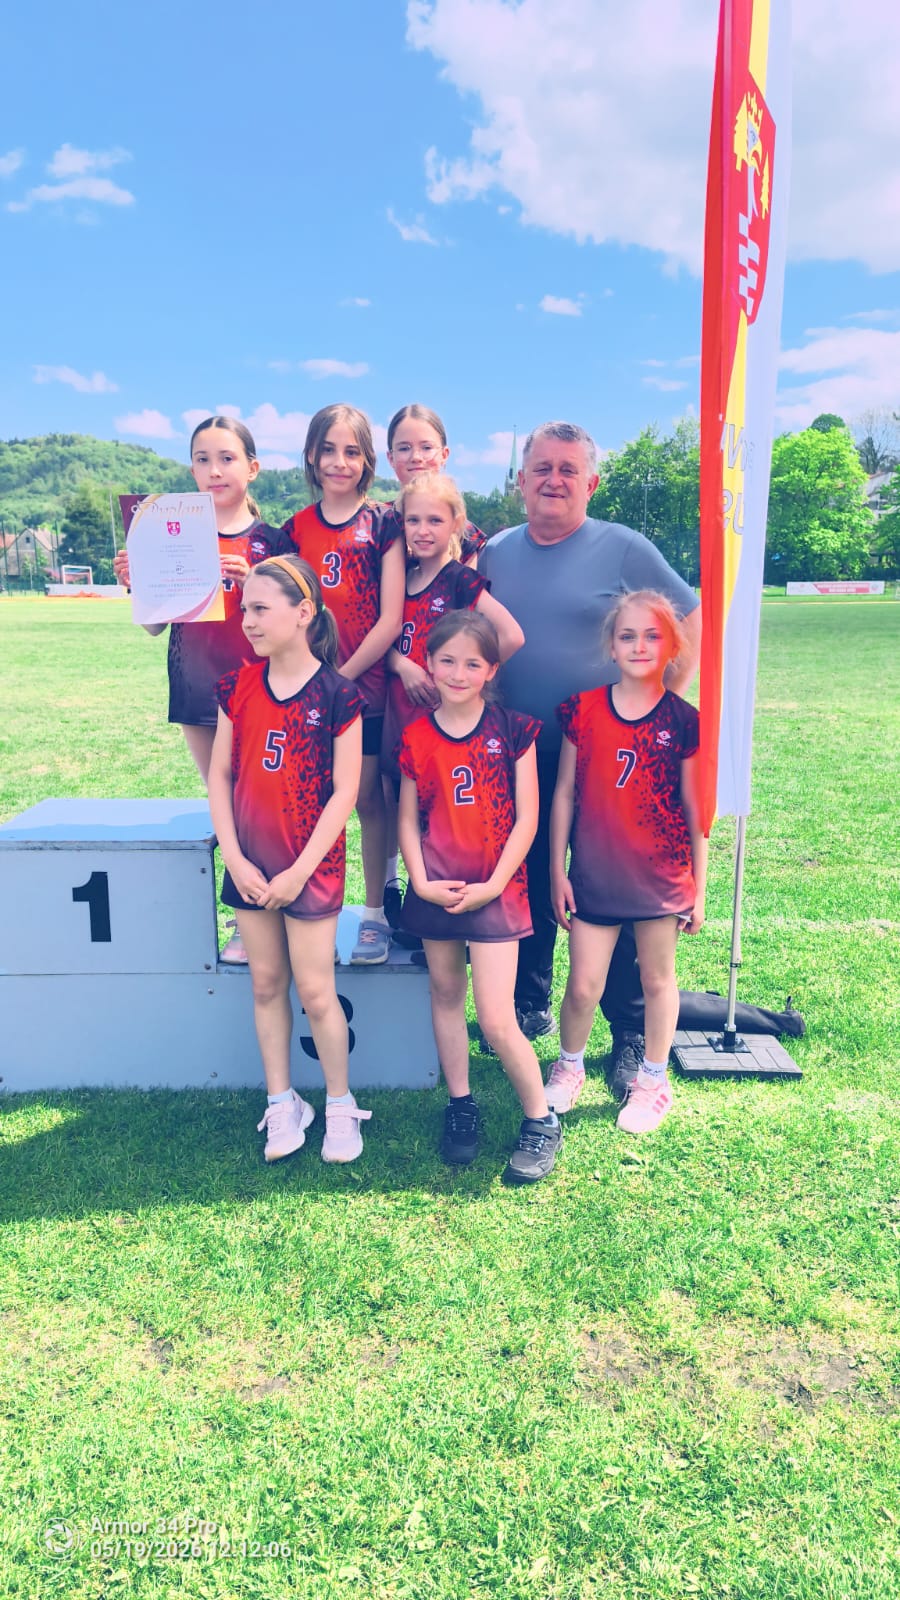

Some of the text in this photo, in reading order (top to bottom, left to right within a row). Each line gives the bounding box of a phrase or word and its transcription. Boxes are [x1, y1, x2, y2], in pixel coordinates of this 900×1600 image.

[321, 552, 342, 588] 3
[399, 622, 415, 656] 6
[262, 729, 287, 772] 5
[616, 748, 637, 788] 7
[451, 765, 475, 806] 2
[71, 871, 112, 942] 1
